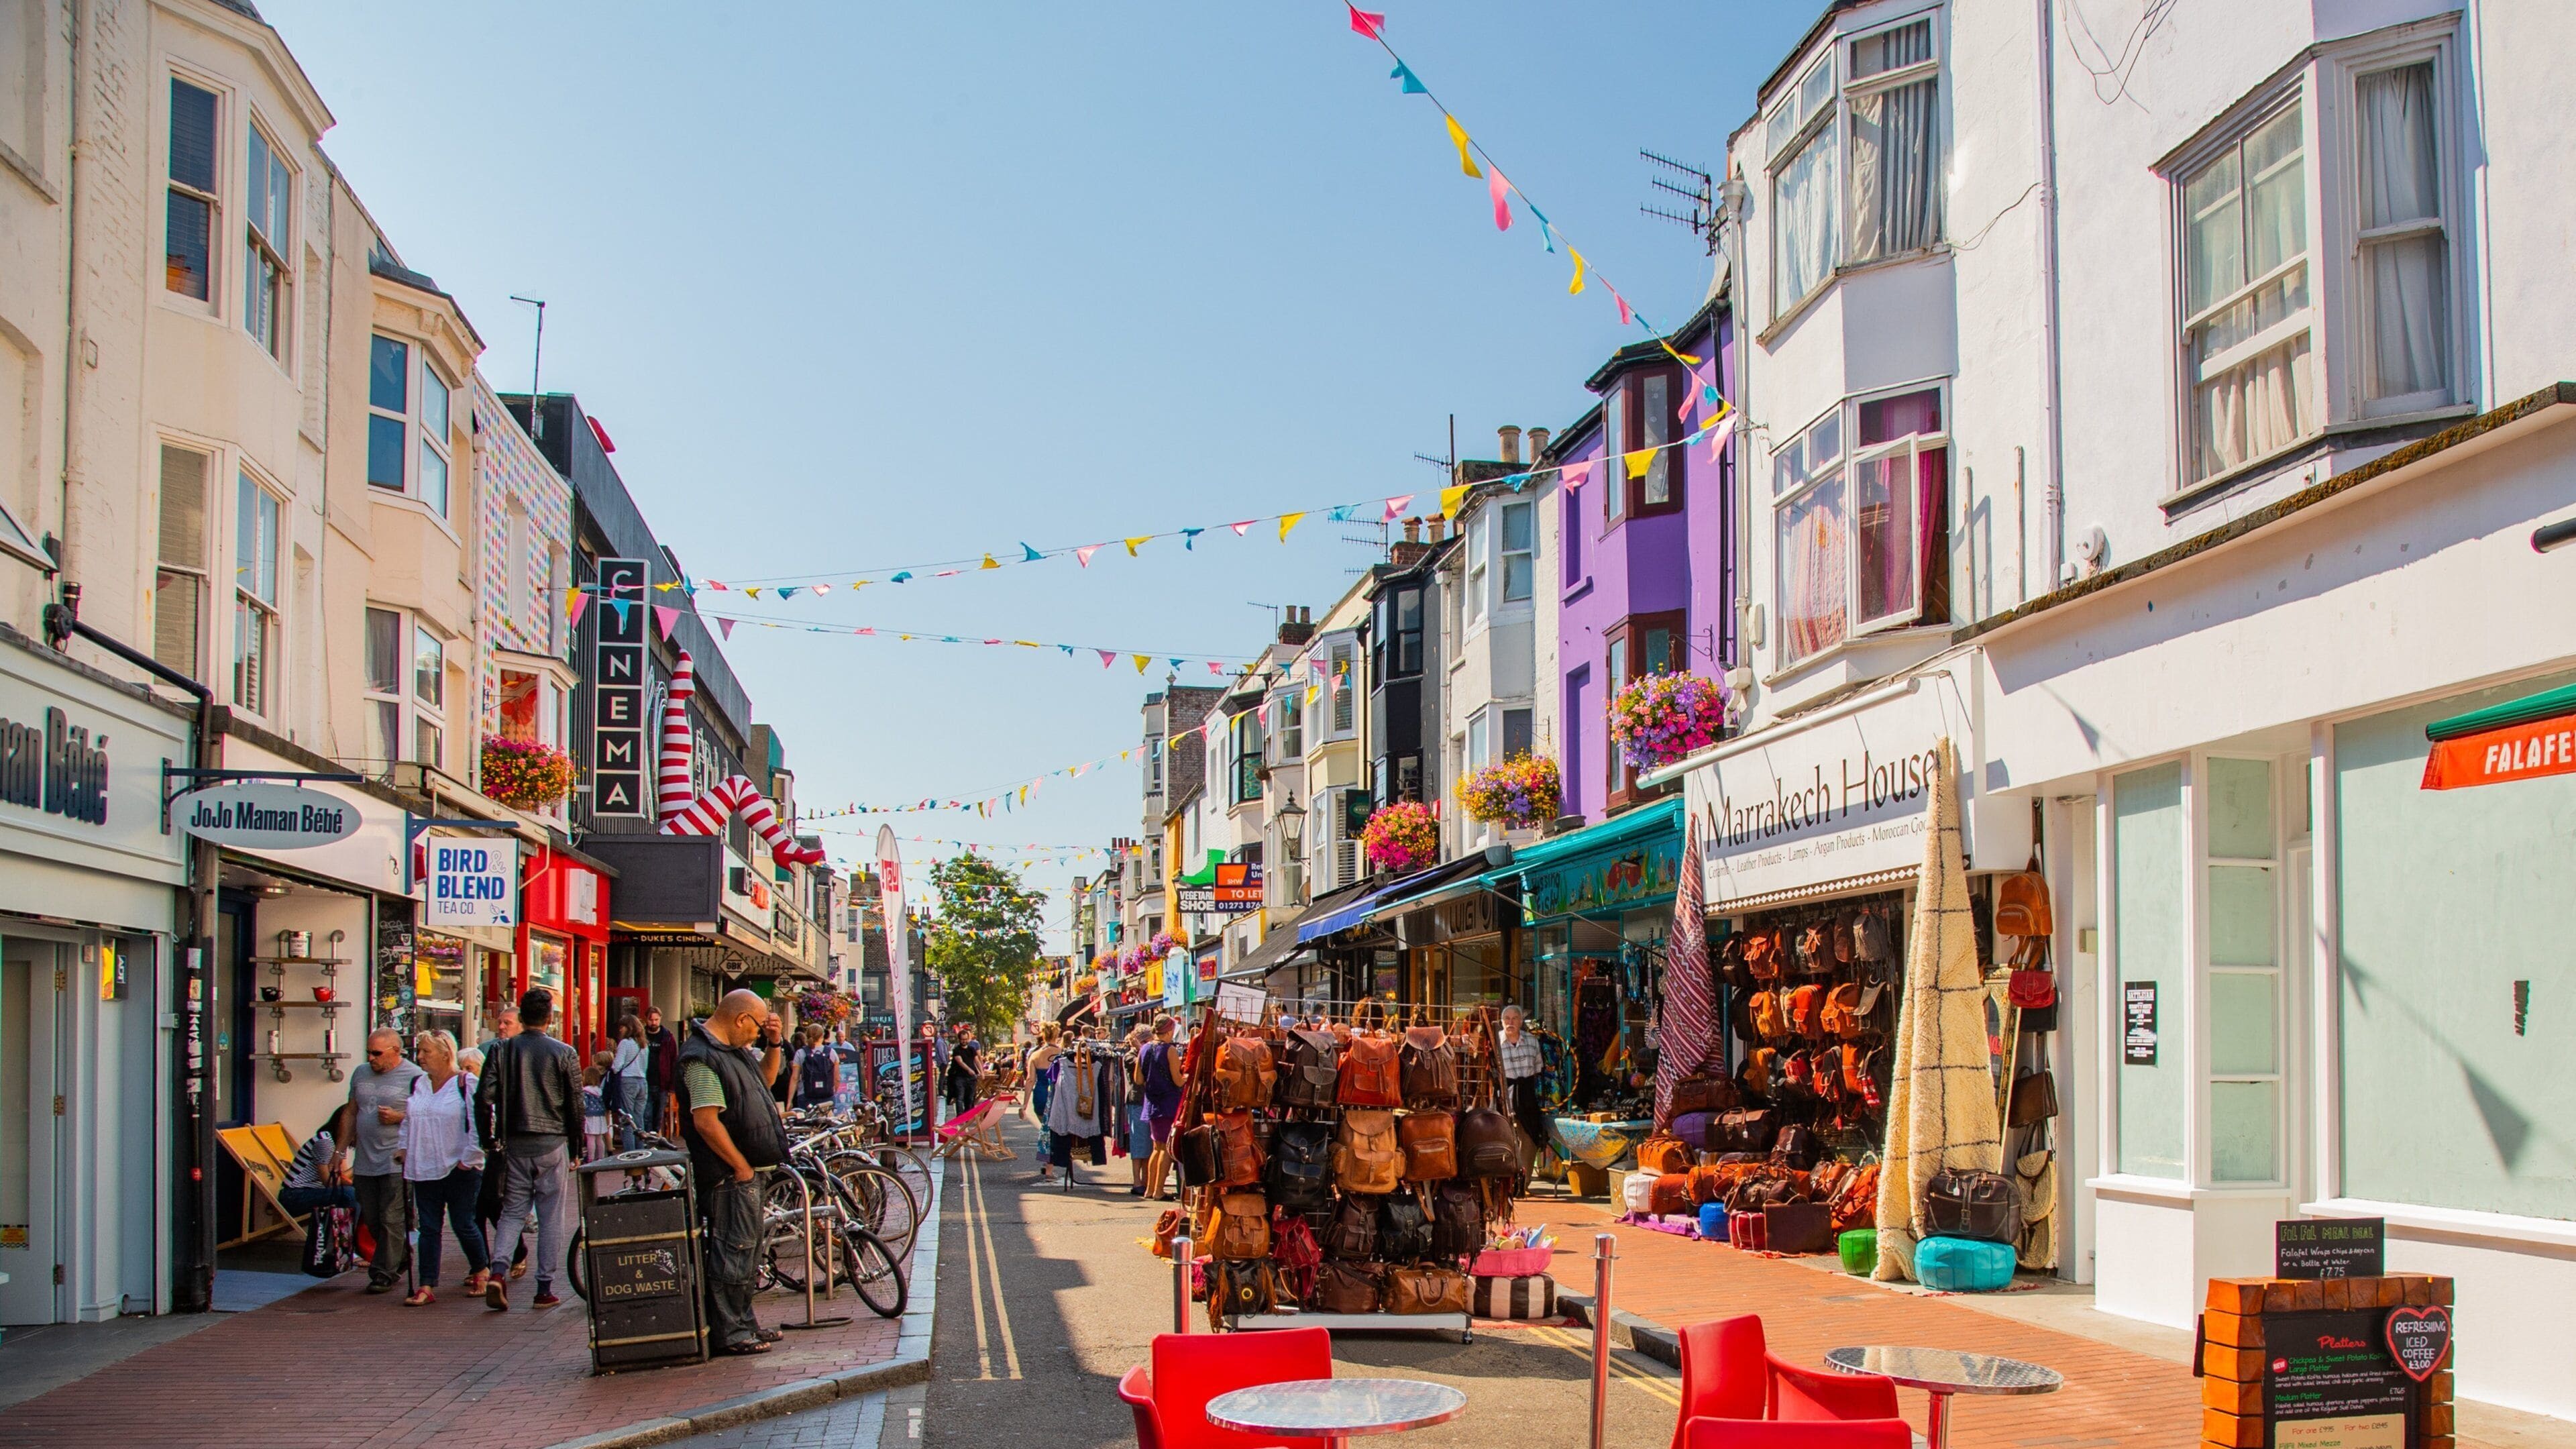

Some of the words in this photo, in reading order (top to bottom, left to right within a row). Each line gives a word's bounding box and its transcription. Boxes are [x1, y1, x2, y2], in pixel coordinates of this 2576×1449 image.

[605, 570, 633, 806] CINEMA
[2485, 730, 2576, 775] FALAFE
[44, 706, 109, 826] Bébé
[1707, 764, 1831, 853] Marrakech
[1843, 749, 1935, 818] House
[191, 800, 233, 828] JoJo
[235, 802, 299, 832] Maman
[301, 804, 343, 834] Bébé
[1737, 858, 1757, 873] Leather
[1758, 852, 1781, 867] Products
[1788, 847, 1809, 862] Lamps
[1814, 841, 1835, 857] Argan
[1837, 833, 1865, 850] Products
[1872, 824, 1909, 843] Moroccan
[437, 848, 488, 873] BIRD
[489, 850, 507, 874] &
[437, 875, 506, 900] BLEND
[1231, 890, 1244, 898] TO
[1248, 890, 1263, 898] LET
[437, 901, 458, 914] TEA
[460, 902, 476, 914] CO.
[1180, 900, 1215, 911] SHOE
[1218, 902, 1244, 910] 01273
[2322, 1226, 2350, 1240] MEAL
[2352, 1226, 2374, 1239] DEAL
[2281, 1248, 2308, 1258] Falafel
[2310, 1246, 2330, 1256] Wraps
[2332, 1247, 2347, 1255] Chips
[618, 1253, 658, 1266] LITTER
[2301, 1259, 2321, 1267] Bottle
[635, 1269, 643, 1279] &
[605, 1283, 632, 1295] DOG
[635, 1280, 676, 1293] WASTE
[2395, 1320, 2447, 1334] REFRESHING
[2317, 1335, 2366, 1350] Platters
[2406, 1336, 2428, 1348] ICED
[2288, 1356, 2316, 1365] Chickpea
[2326, 1354, 2345, 1363] Sweet
[2347, 1353, 2367, 1361] Potato
[2402, 1348, 2435, 1359] COFFEE
[2273, 1361, 2286, 1370] NEW
[2289, 1366, 2308, 1375] Large
[2309, 1364, 2331, 1372] Platter
[2300, 1392, 2322, 1400] Platter
[2320, 1440, 2341, 1448] Mezze
